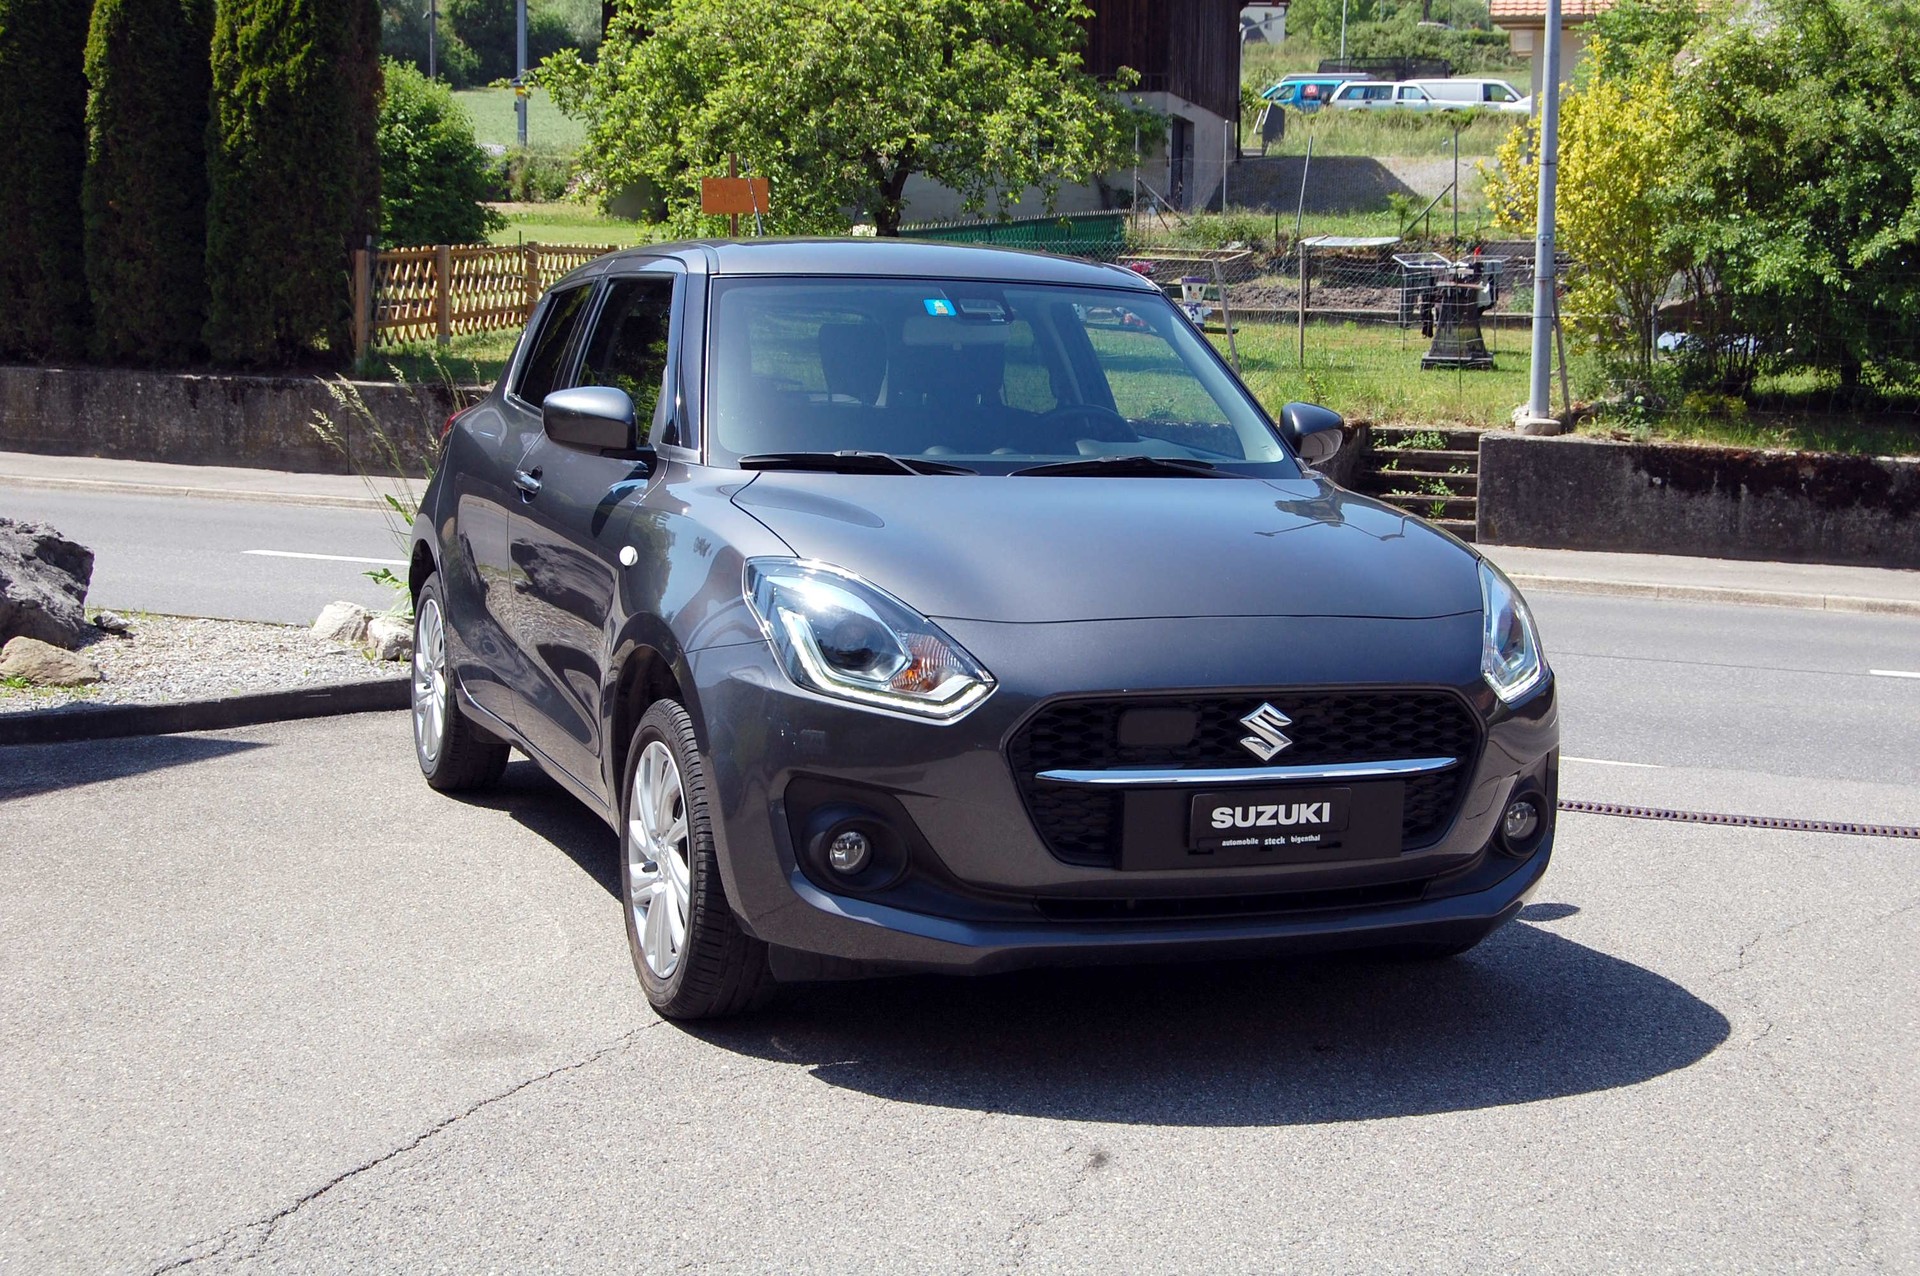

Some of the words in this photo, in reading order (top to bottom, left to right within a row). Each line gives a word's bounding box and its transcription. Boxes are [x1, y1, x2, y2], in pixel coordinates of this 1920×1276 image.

[1211, 802, 1331, 829] SUZUKI
[1222, 837, 1259, 847] automobile
[1264, 836, 1286, 845] steck
[1290, 834, 1321, 844] bigenthal
